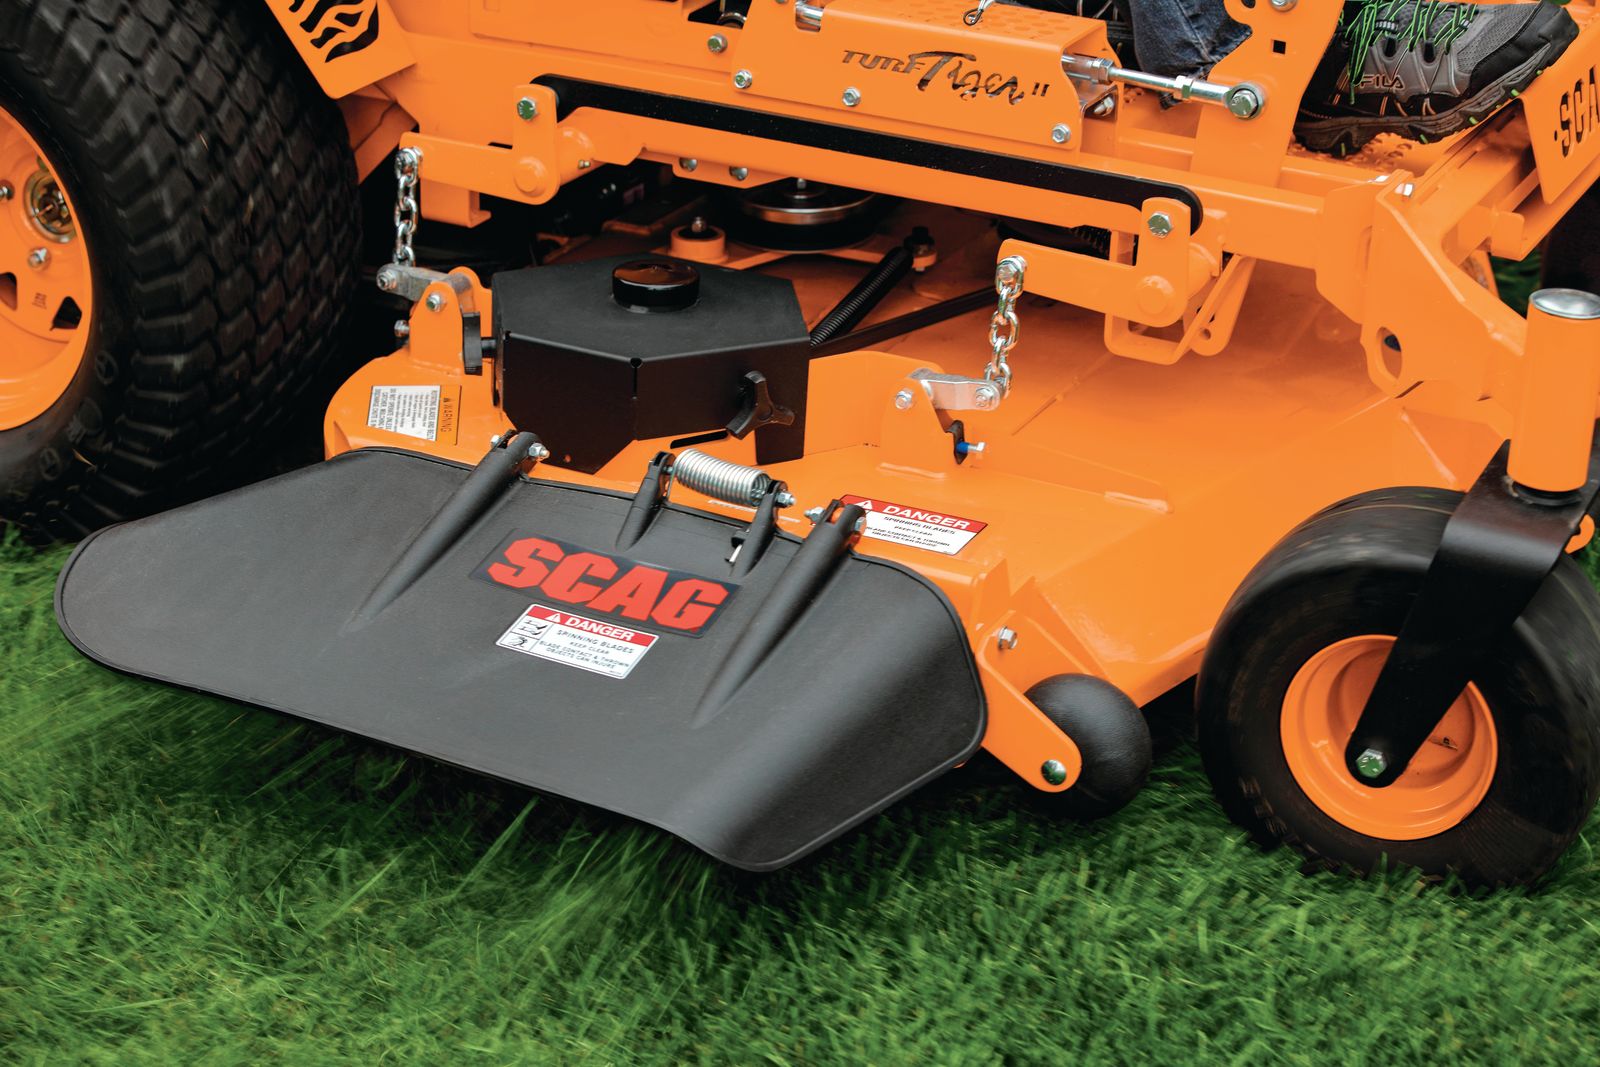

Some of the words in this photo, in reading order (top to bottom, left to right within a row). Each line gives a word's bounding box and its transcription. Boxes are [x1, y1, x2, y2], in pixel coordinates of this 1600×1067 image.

[842, 50, 926, 74] TURF
[1360, 73, 1405, 90] FILA
[883, 505, 971, 529] DANGER
[487, 537, 730, 630] SCAG
[555, 629, 601, 644] SPINNING
[599, 641, 635, 653] BLADES
[563, 617, 636, 641] DANGER
[568, 641, 588, 649] KEEP
[587, 646, 610, 654] CLEAR
